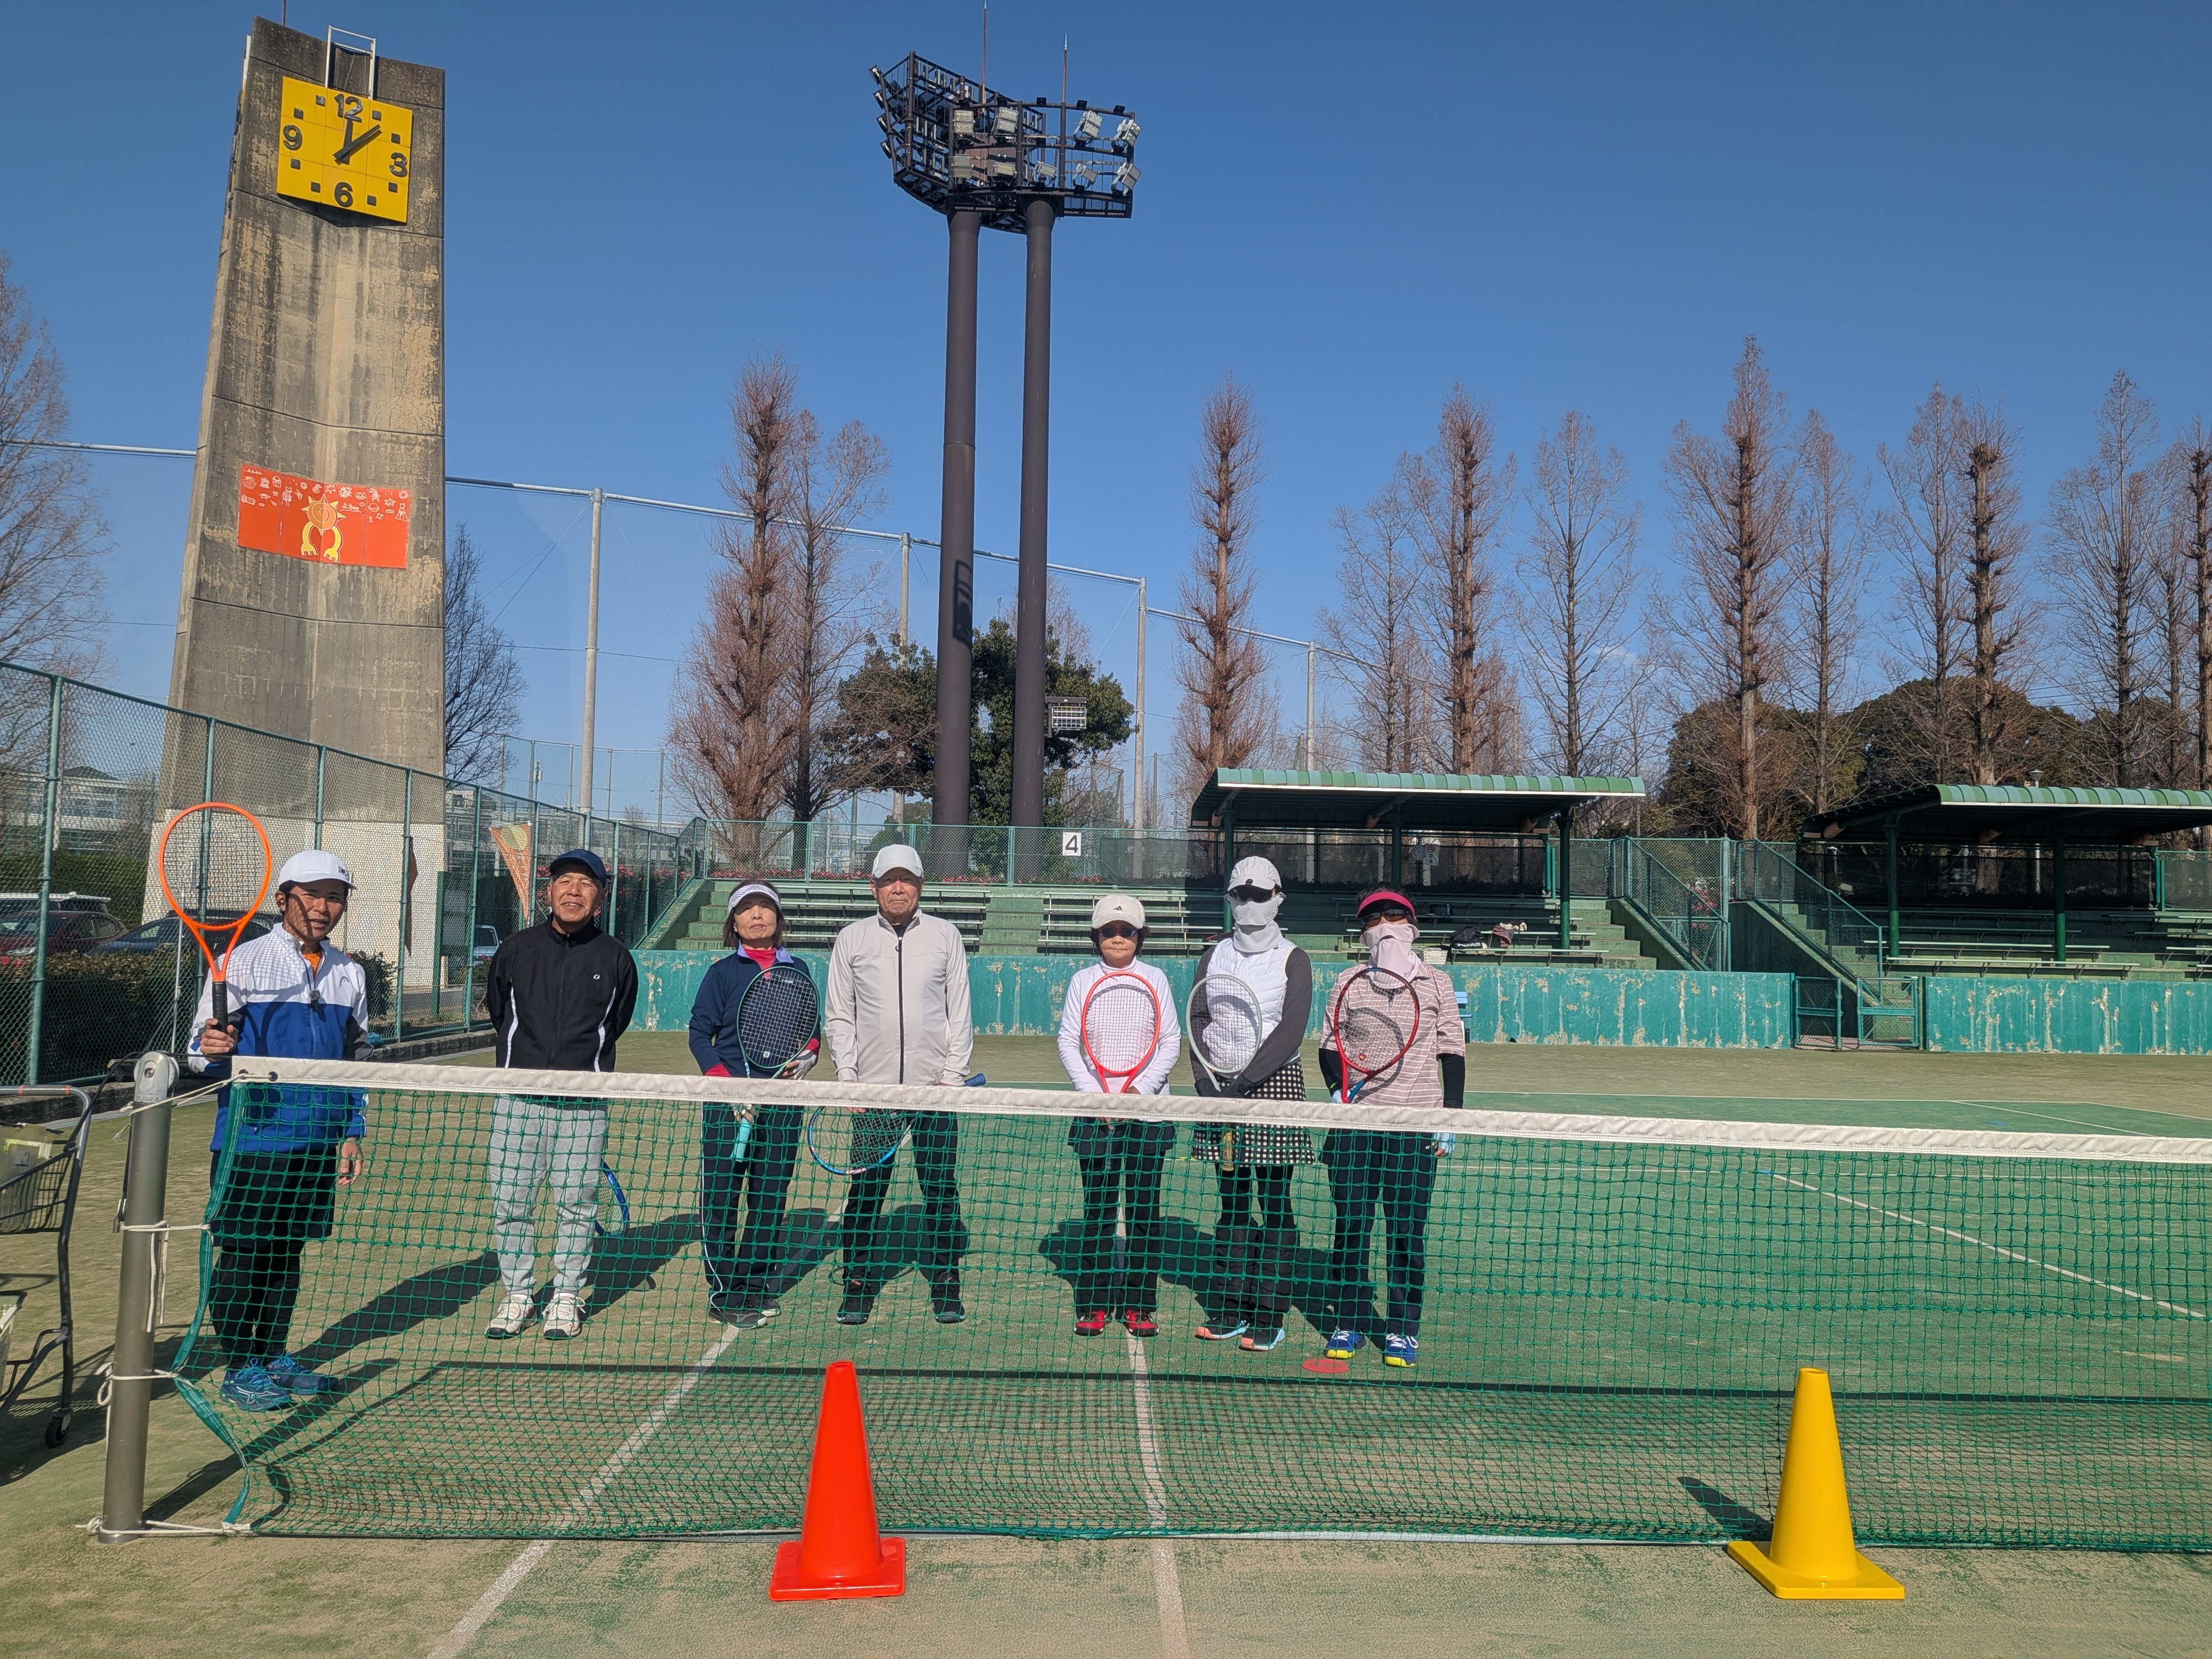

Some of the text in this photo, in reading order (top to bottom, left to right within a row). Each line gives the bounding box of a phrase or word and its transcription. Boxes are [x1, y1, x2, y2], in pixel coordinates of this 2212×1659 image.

[334, 93, 363, 123] 12
[283, 124, 302, 150] 9
[389, 152, 408, 178] 3
[334, 182, 353, 207] 6
[1065, 835, 1078, 853] 4
